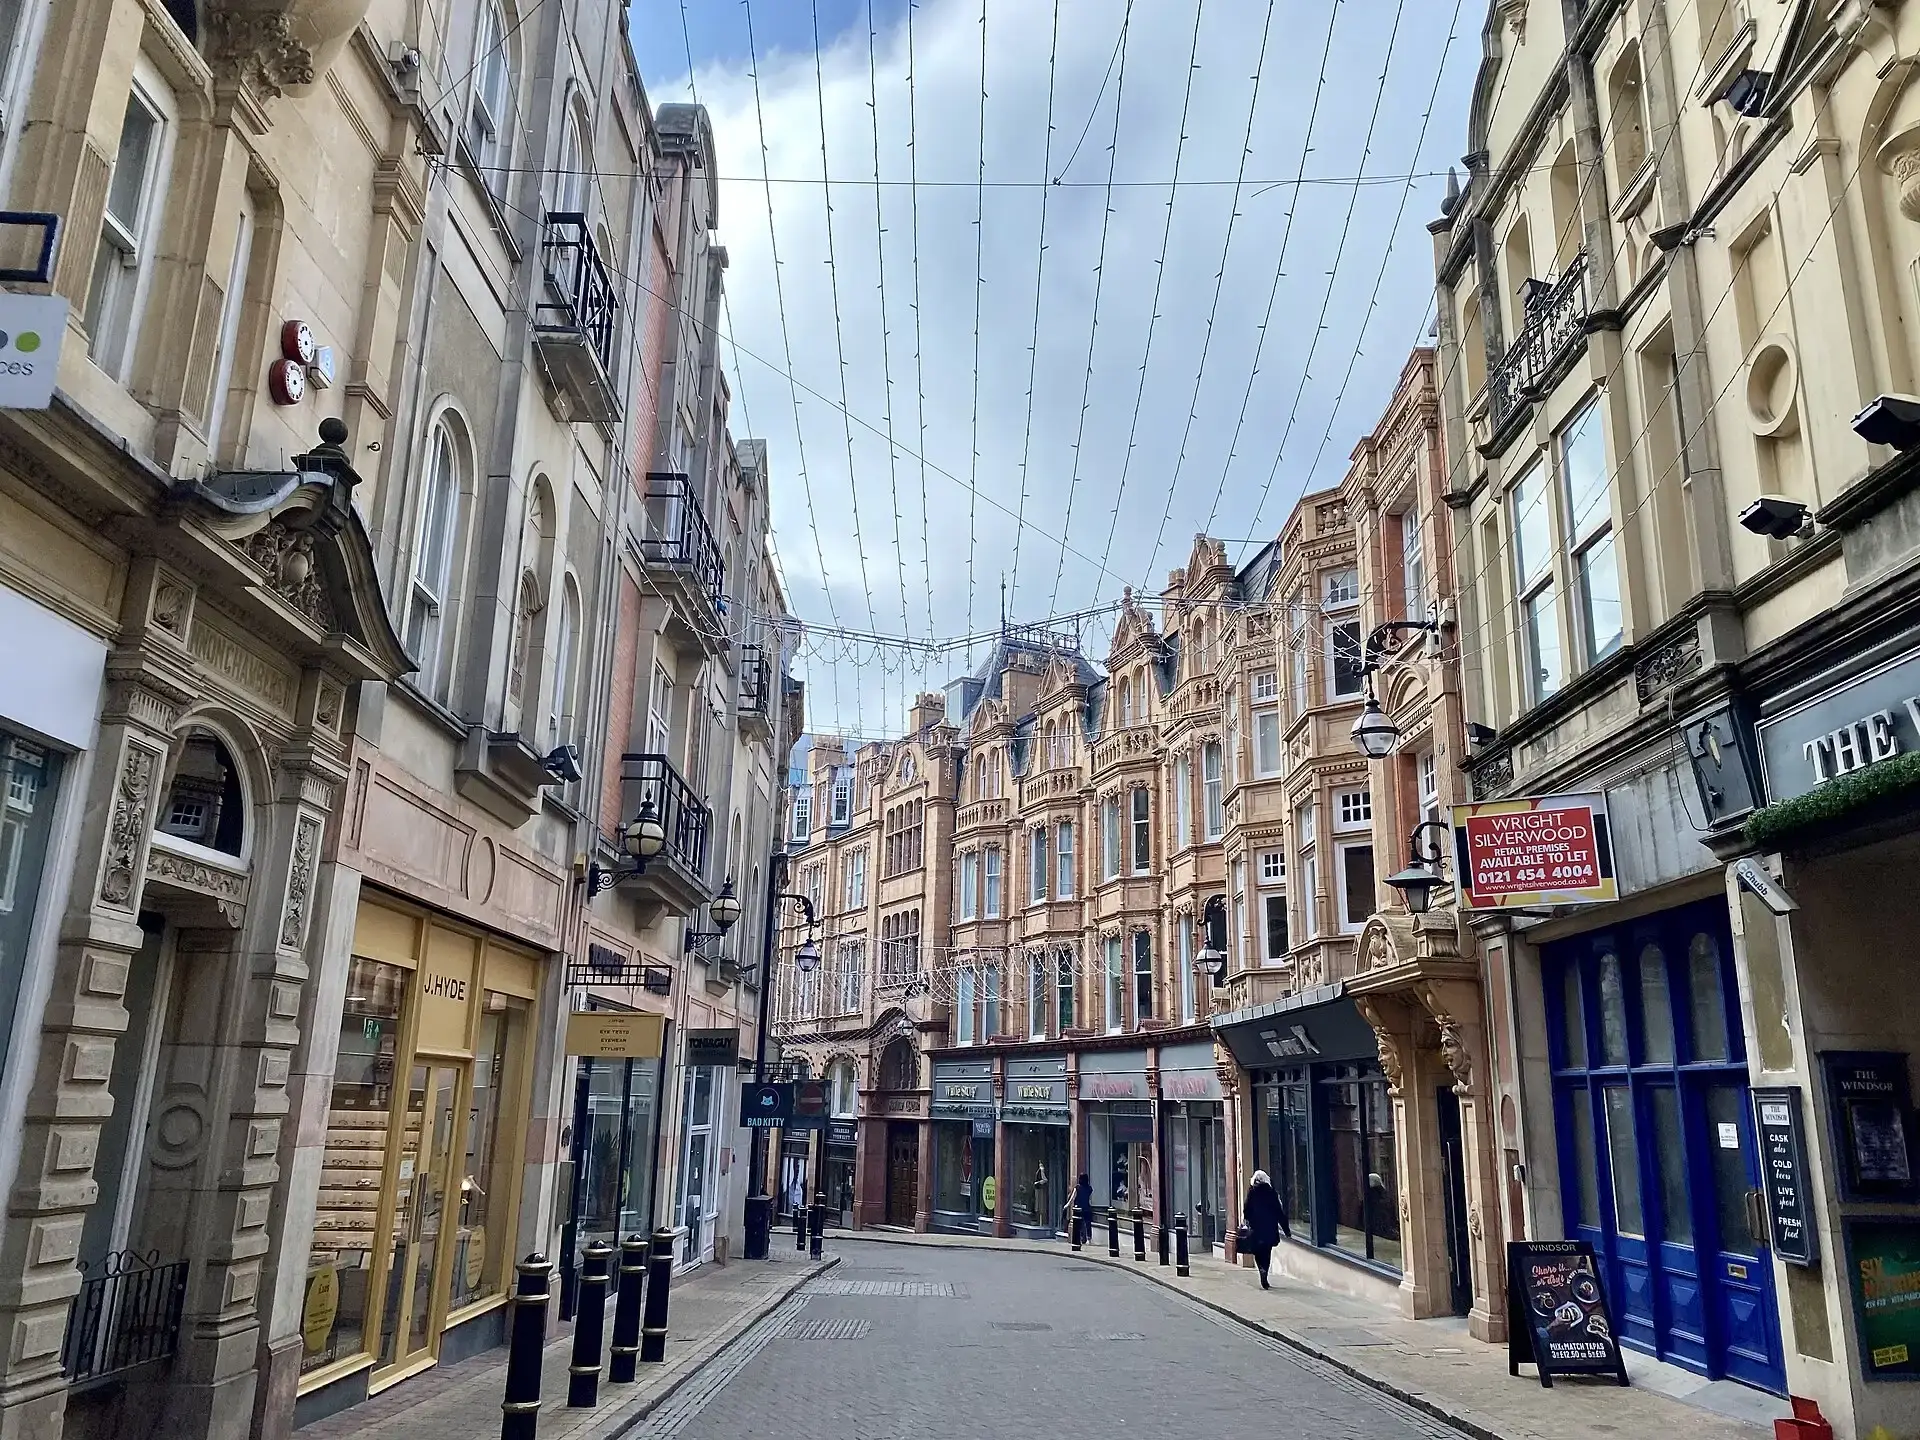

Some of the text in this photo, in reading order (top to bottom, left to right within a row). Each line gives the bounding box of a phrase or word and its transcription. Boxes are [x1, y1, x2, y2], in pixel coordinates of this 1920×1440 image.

[1803, 708, 1897, 785] THE
[1492, 813, 1564, 831] WRIGHT
[1475, 826, 1587, 848] SILVERWOOD
[1494, 843, 1570, 856] RETAIL PREMISES
[1480, 851, 1588, 869] AVAILABLE TO LET
[1478, 864, 1593, 884] 0121 454 4004
[1485, 879, 1588, 892] www.wrightsilverwood.co.uk
[1745, 871, 1768, 896] Chubb
[424, 973, 466, 1001] J.HYDE
[1854, 1070, 1878, 1079] THE
[1841, 1081, 1893, 1091] WINDSOR
[747, 1117, 785, 1126] BAD KITTY
[1765, 1113, 1788, 1121] WINDSOR
[1769, 1134, 1789, 1142] CASK
[1772, 1160, 1793, 1169] COLD
[1777, 1186, 1795, 1195] LIVE
[1778, 1216, 1802, 1227] FRESH
[1783, 1227, 1799, 1241] food
[1528, 1244, 1577, 1252] WINDSOR
